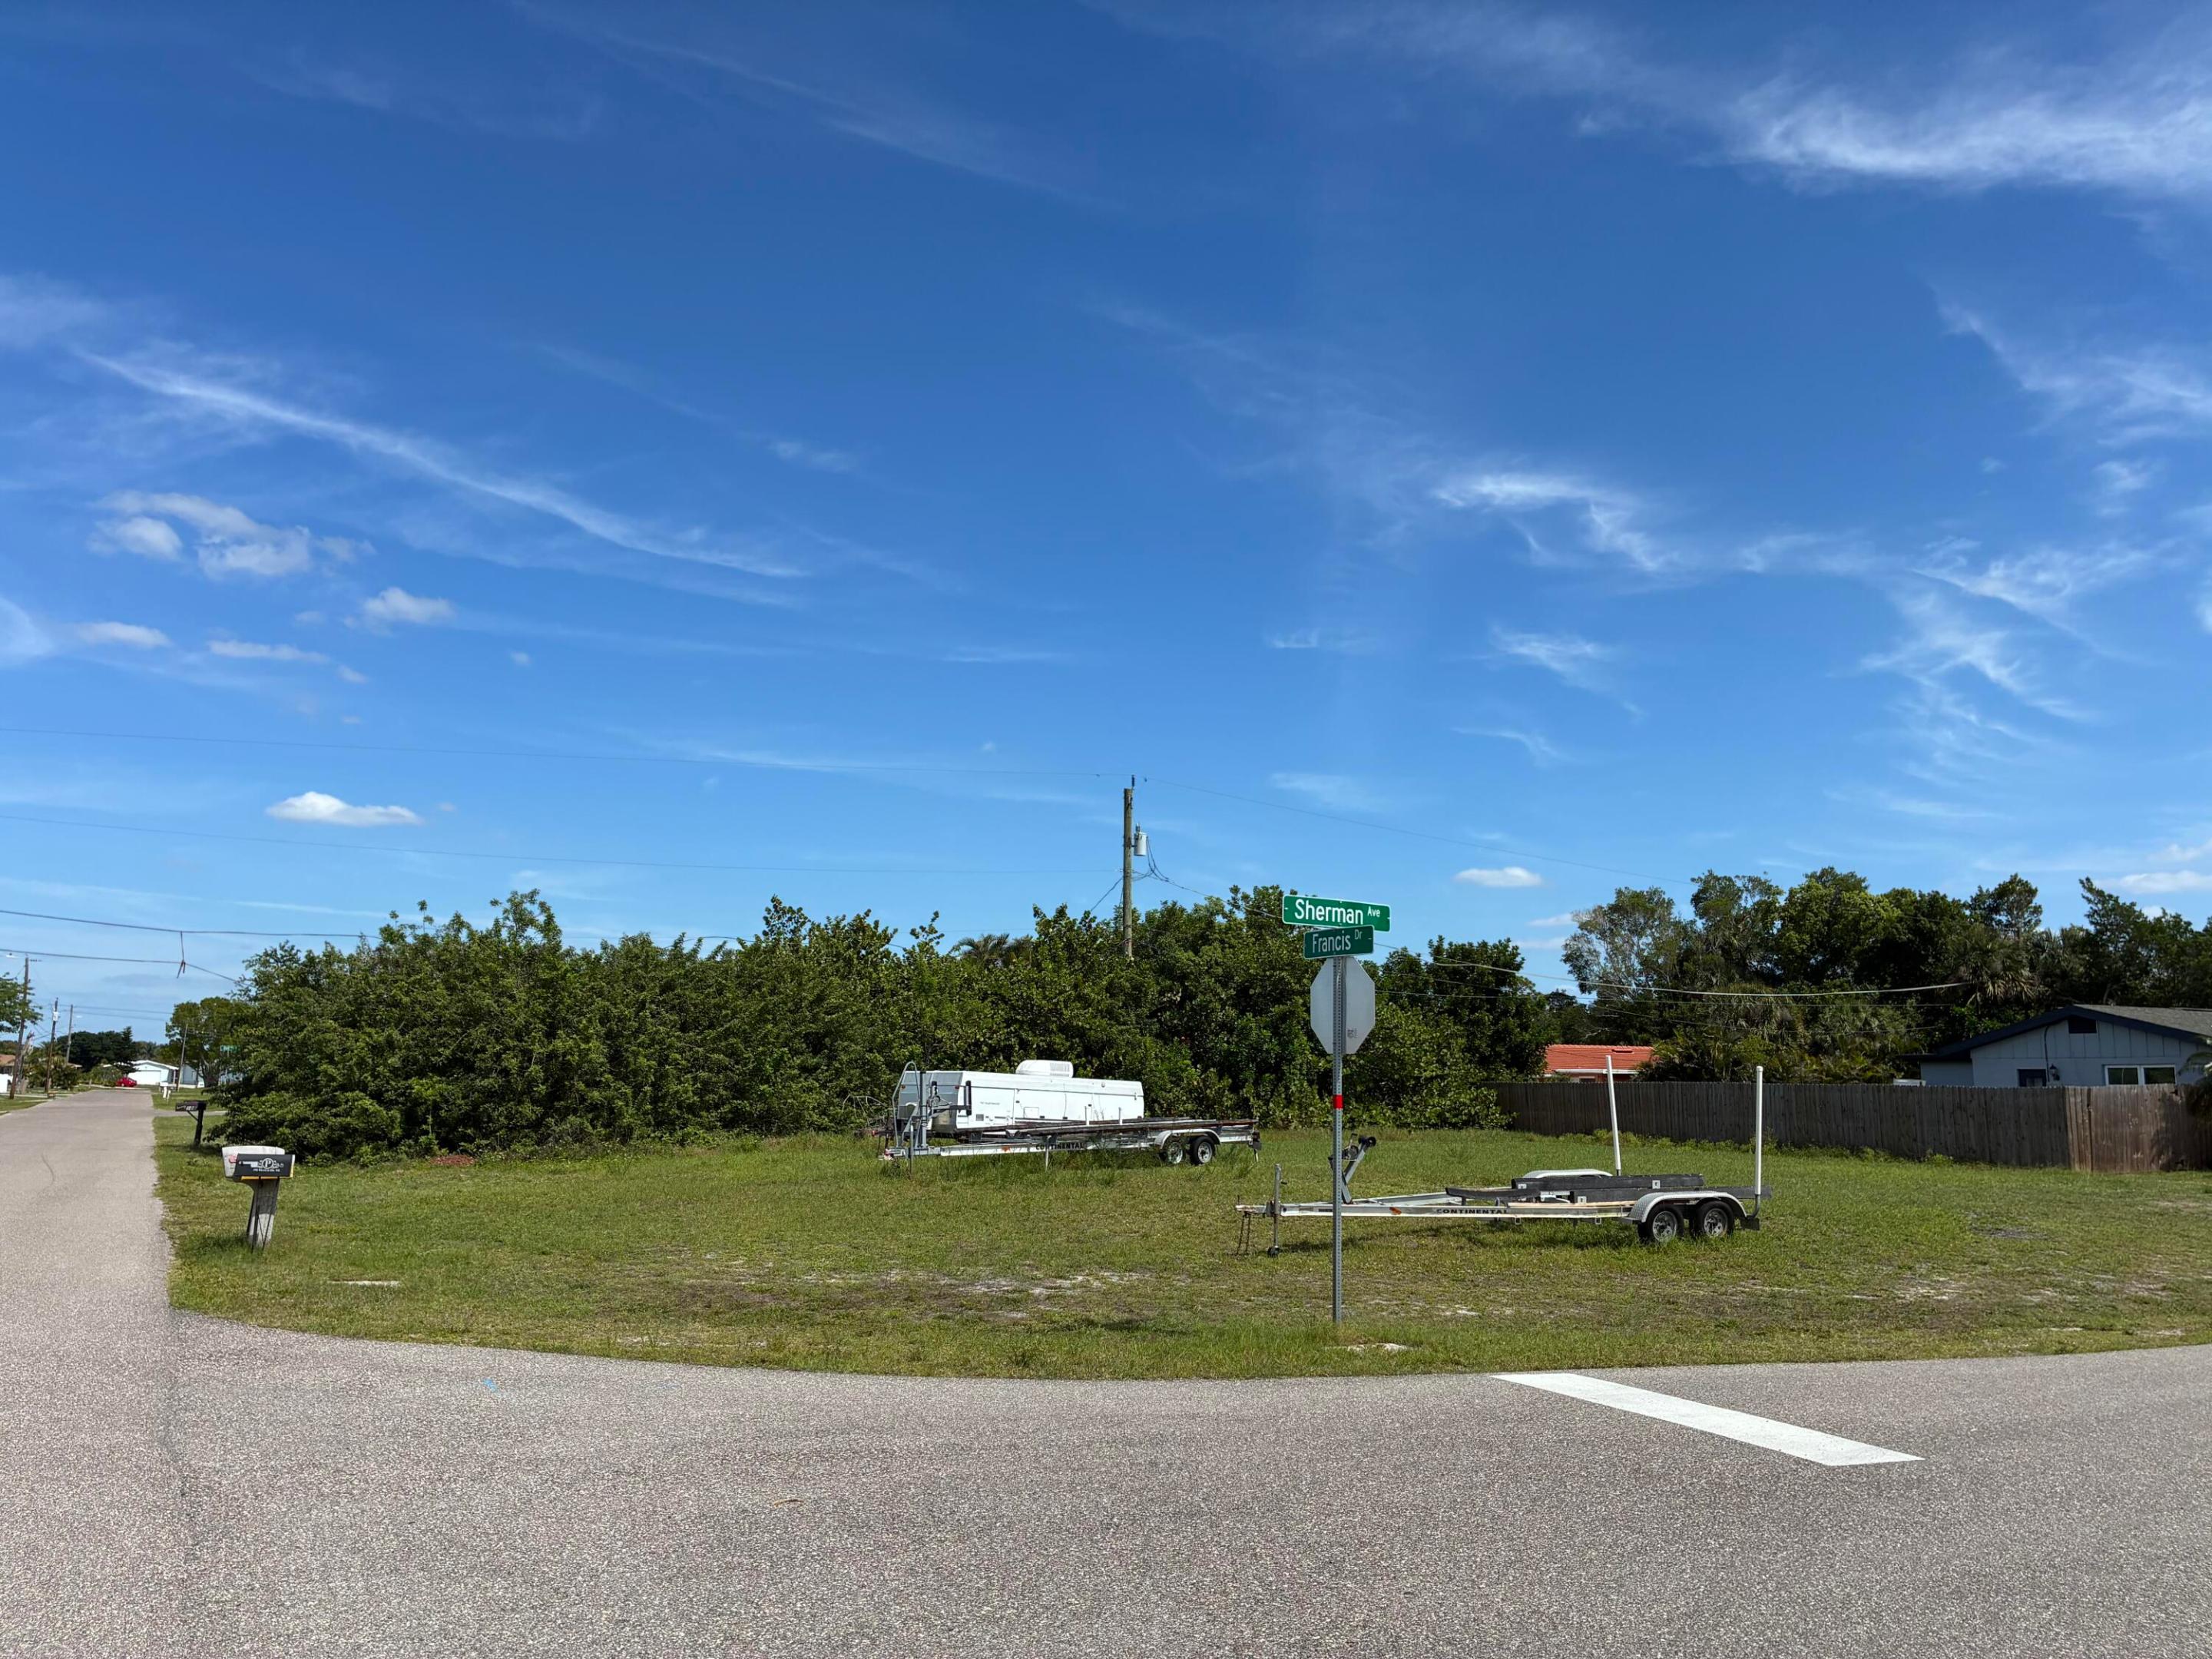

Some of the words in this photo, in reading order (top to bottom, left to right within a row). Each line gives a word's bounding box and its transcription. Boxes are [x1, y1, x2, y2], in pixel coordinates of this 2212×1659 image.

[1295, 899, 1363, 925] Sherman
[1367, 906, 1380, 917] Ave
[1312, 930, 1351, 953] Francis
[1354, 929, 1363, 939] Dr
[1036, 1141, 1084, 1151] COTINENTAL
